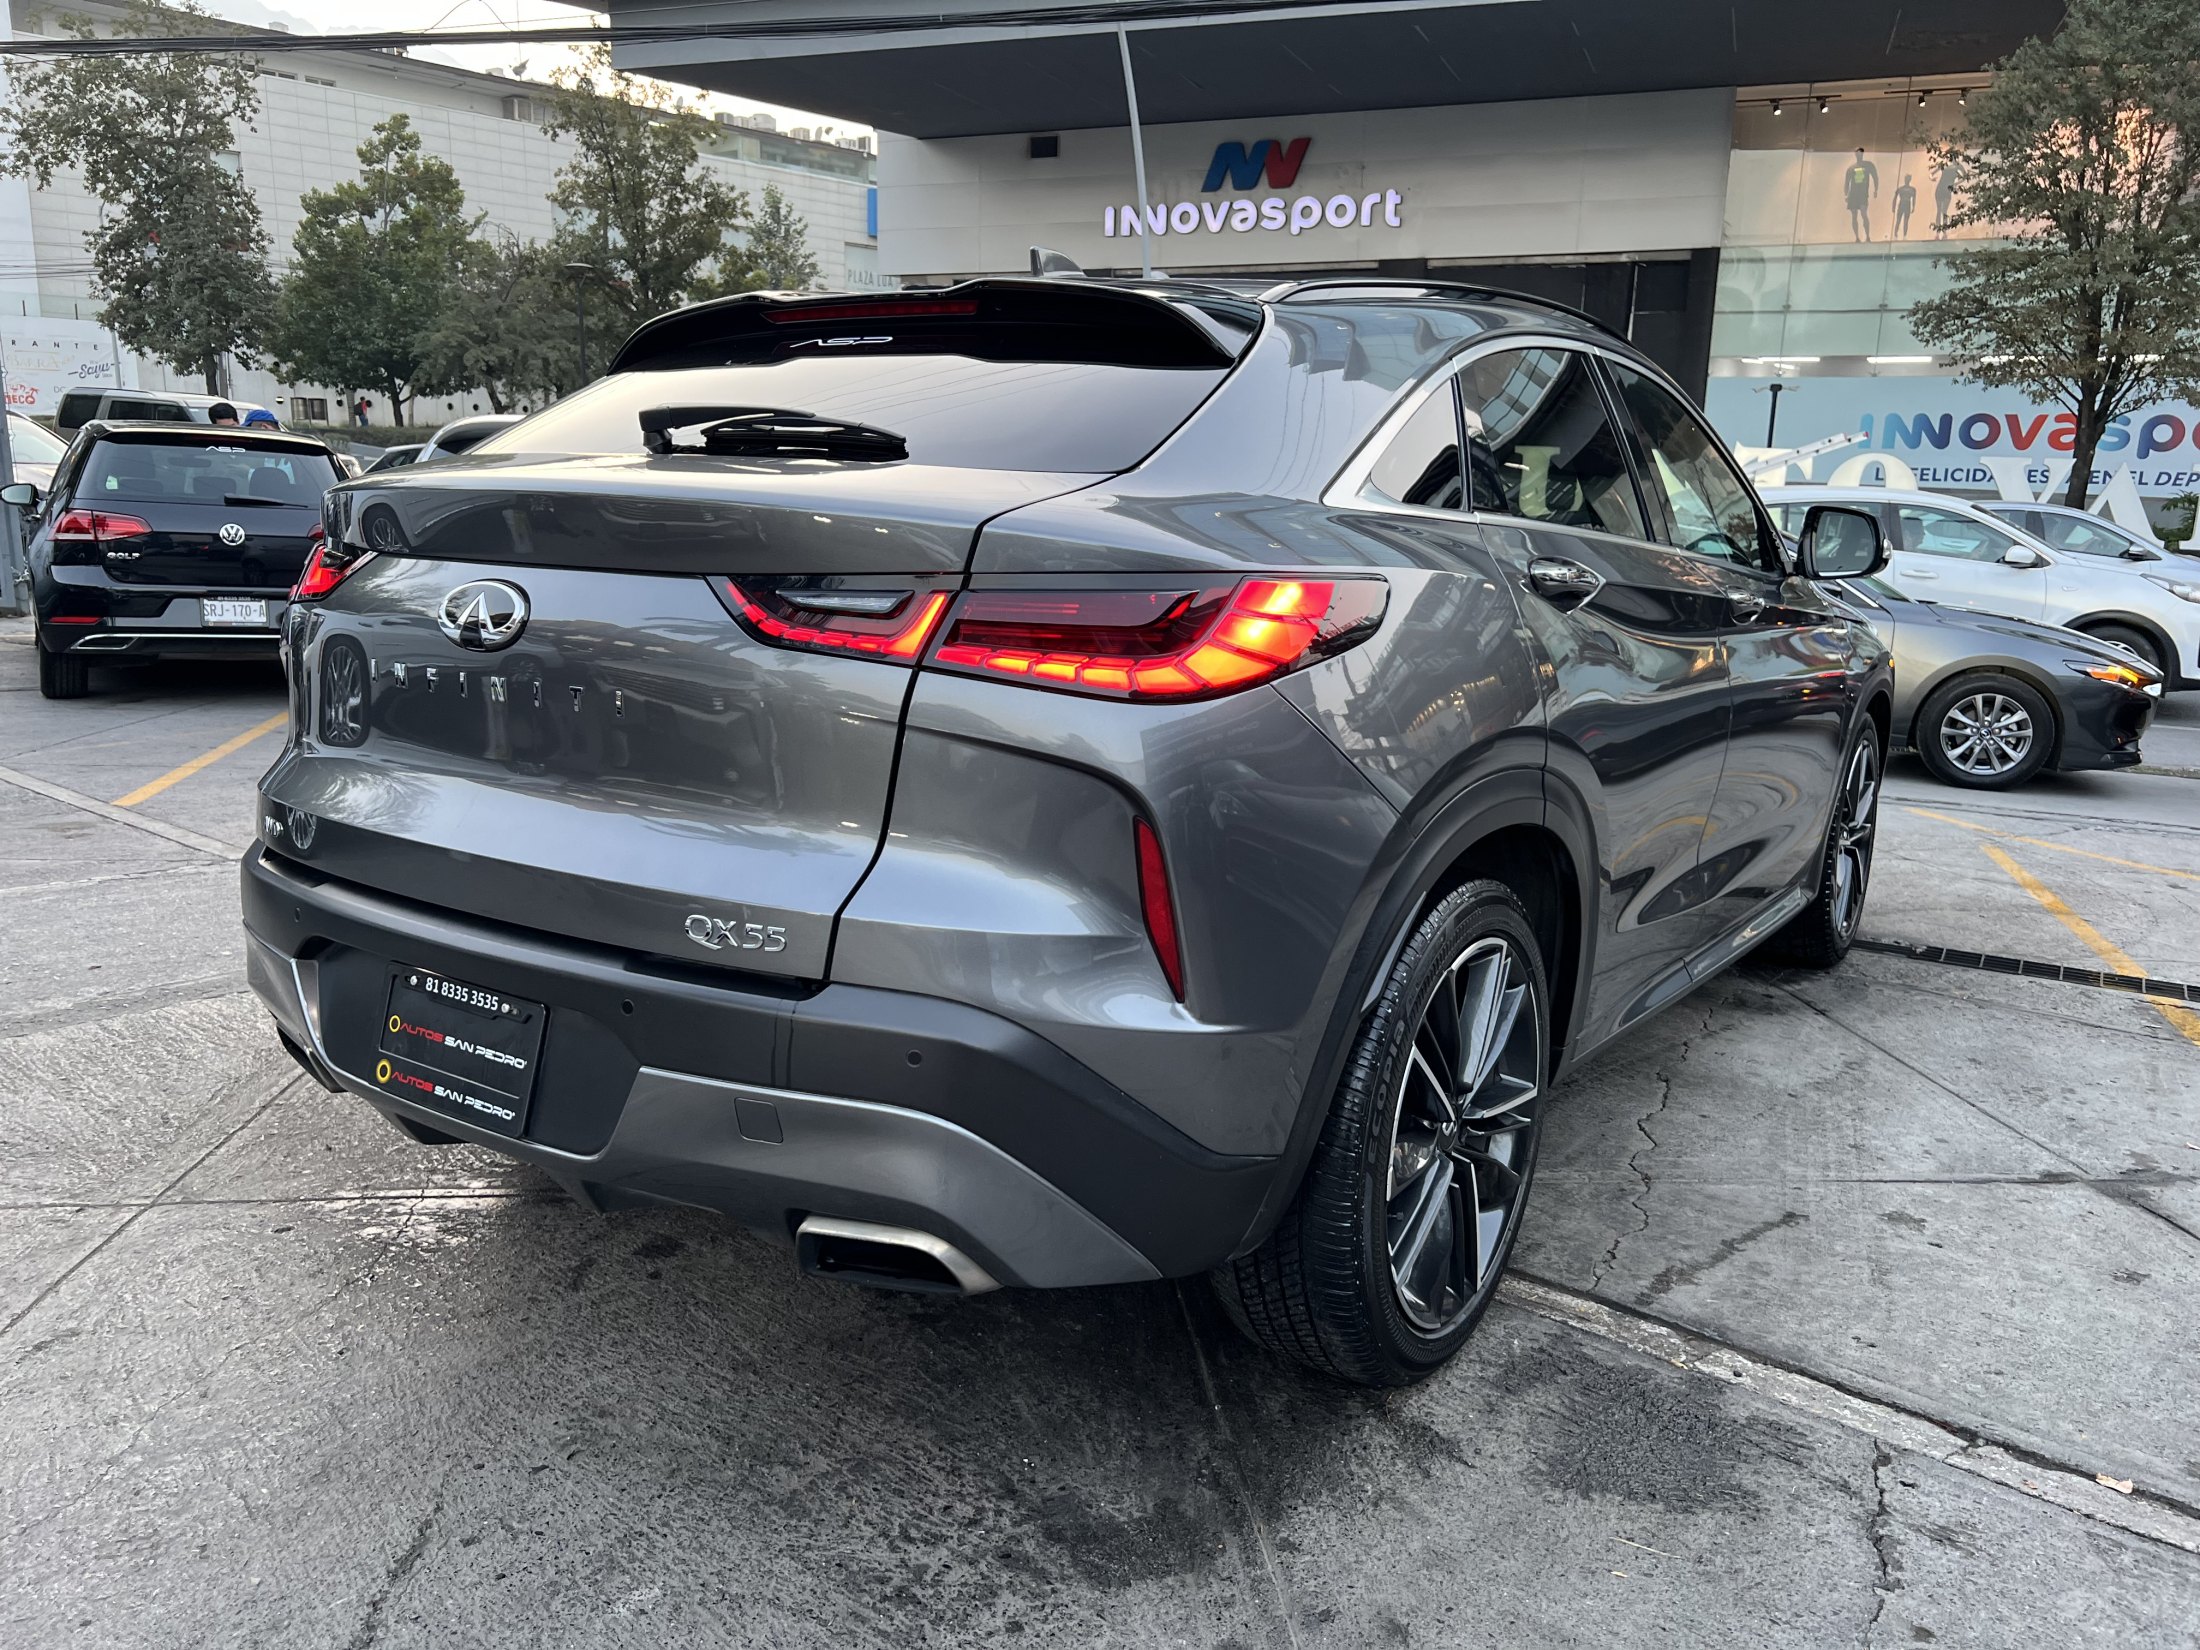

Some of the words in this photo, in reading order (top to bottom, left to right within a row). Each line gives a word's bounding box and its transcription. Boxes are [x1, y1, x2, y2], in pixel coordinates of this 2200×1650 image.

[847, 269, 874, 286] PLAZA
[107, 552, 140, 560] GOLF
[203, 603, 265, 618] SRJ-170-A
[371, 658, 626, 718] INFINITI
[684, 914, 787, 952] QX55
[425, 977, 439, 993] 81
[441, 982, 469, 1002] 8335
[470, 990, 499, 1011] 3535
[400, 1023, 444, 1043] AUTOS
[444, 1035, 474, 1053] SAN
[475, 1045, 526, 1070] PEDRO
[391, 1071, 434, 1093] AUTOS
[434, 1085, 464, 1104] SAN
[464, 1095, 515, 1121] PEDRO
